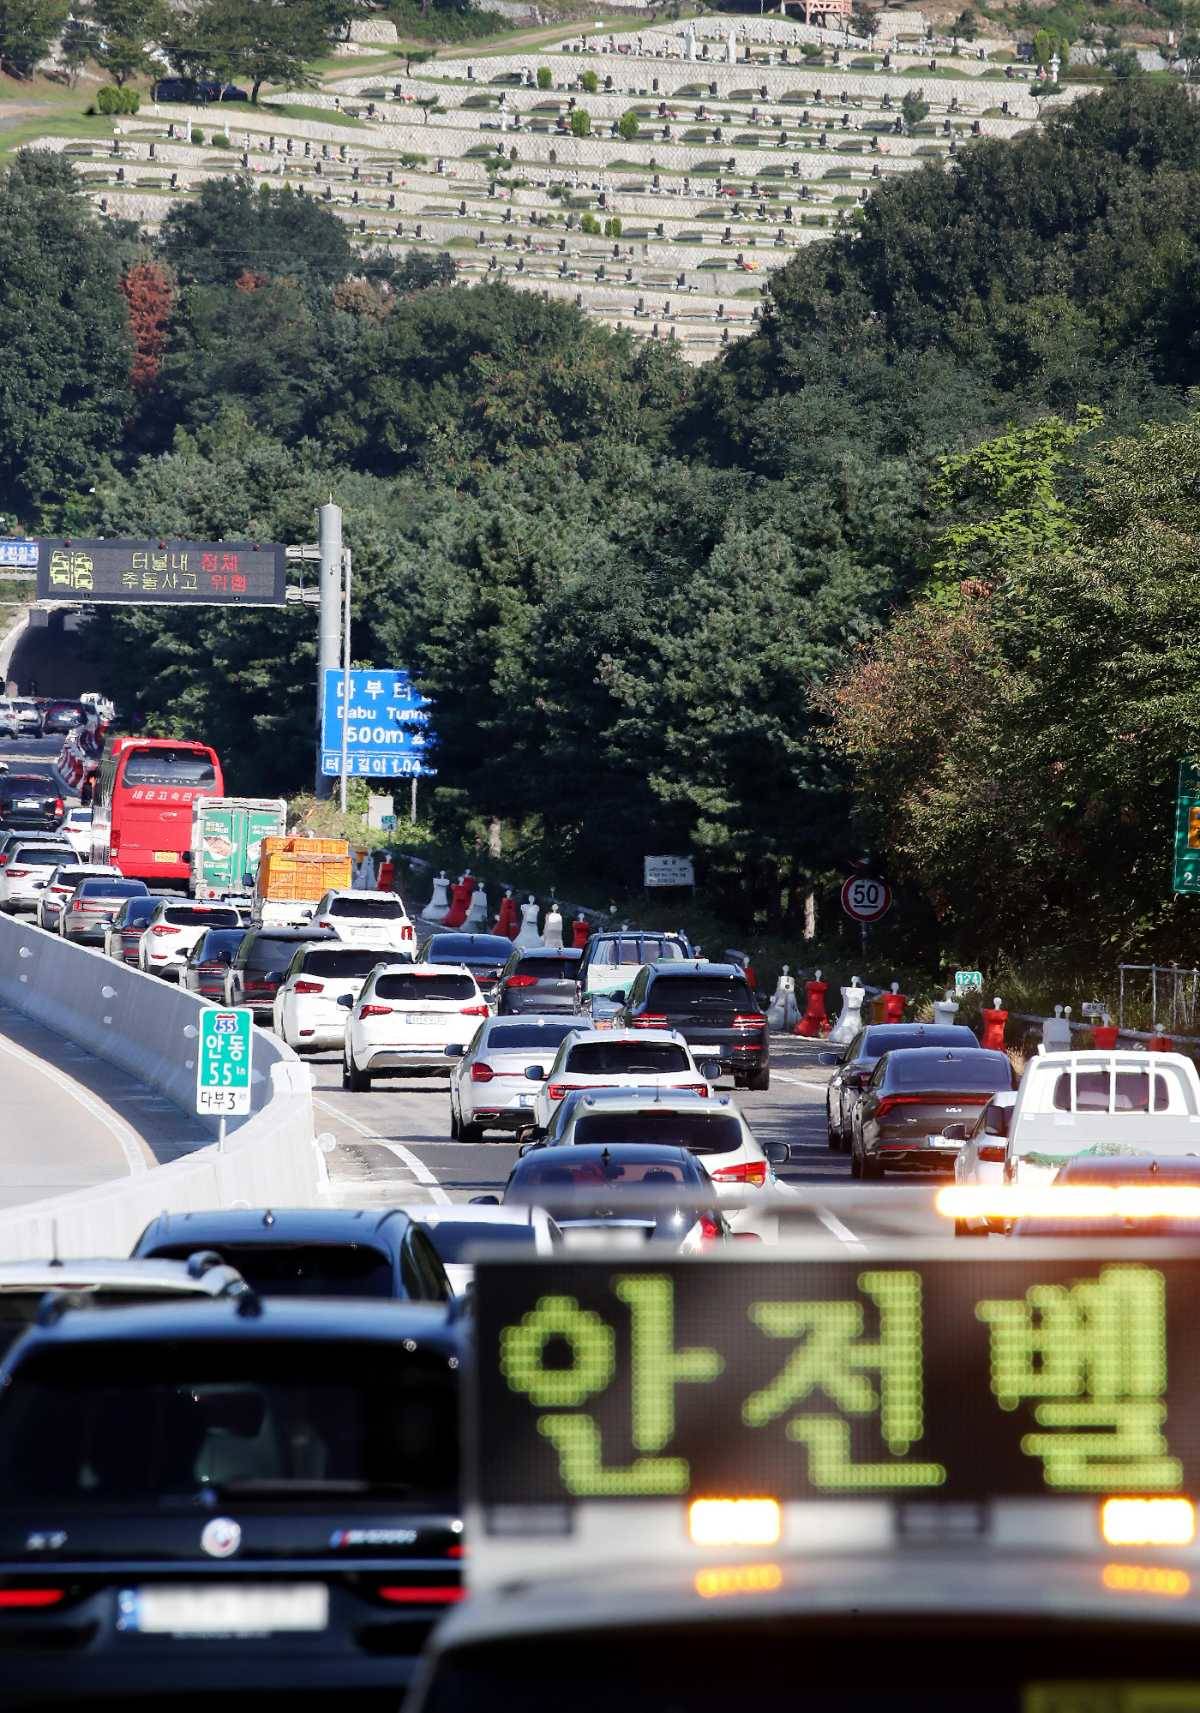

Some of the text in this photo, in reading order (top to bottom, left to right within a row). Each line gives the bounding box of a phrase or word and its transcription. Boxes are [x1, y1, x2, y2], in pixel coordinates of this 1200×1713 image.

[132, 552, 239, 573] 터널내 정체
[122, 572, 248, 593] 추돌사고 위험
[386, 706, 432, 720] Tunne
[347, 726, 404, 744] 500m
[853, 884, 879, 904] 50
[219, 1020, 234, 1031] 55
